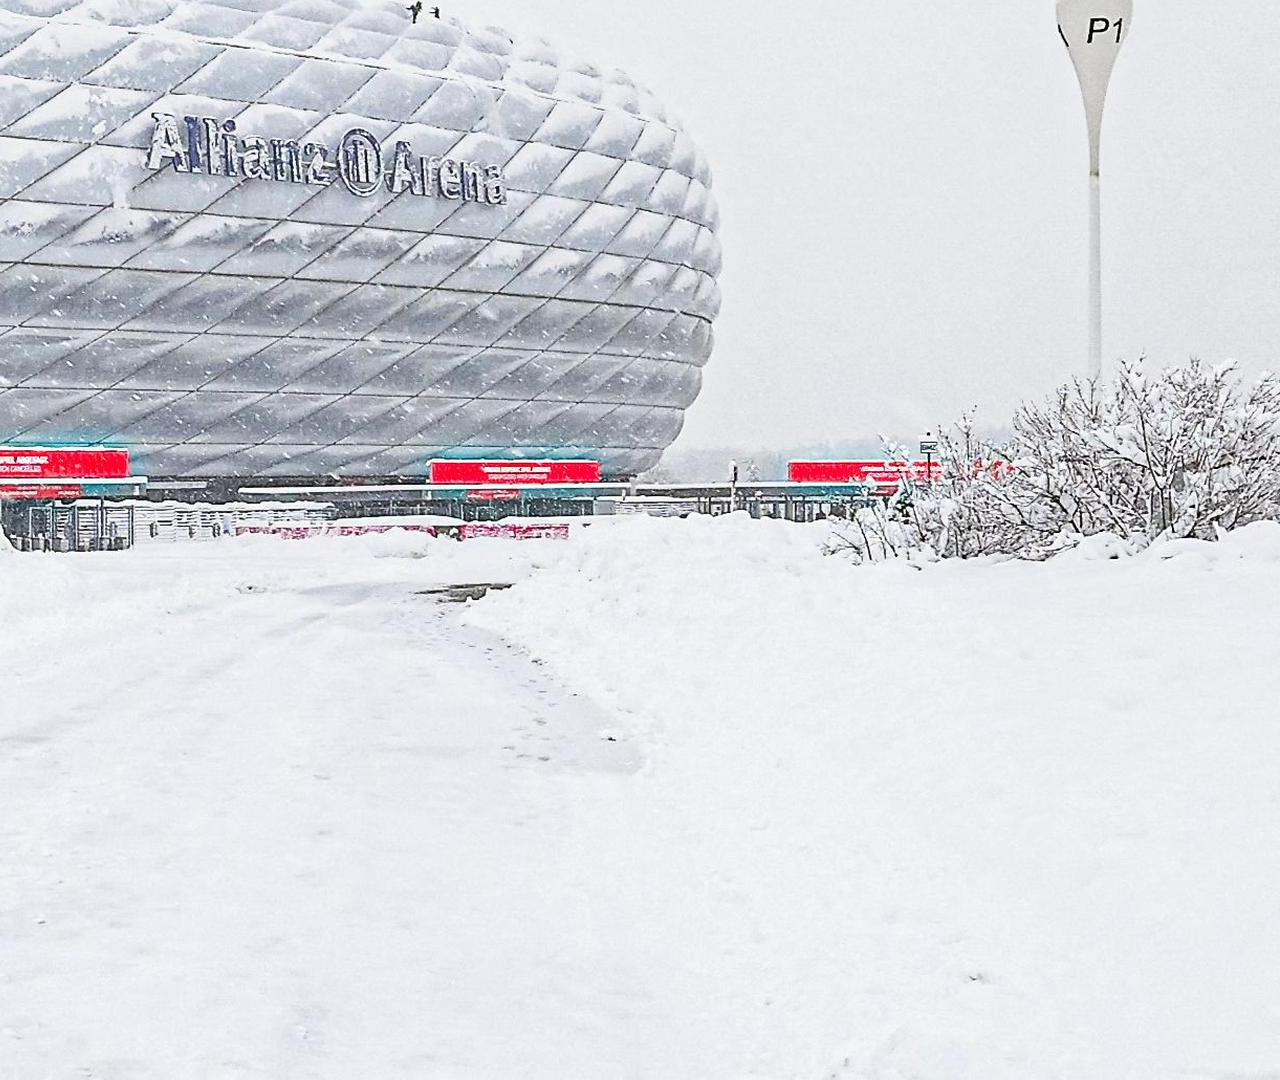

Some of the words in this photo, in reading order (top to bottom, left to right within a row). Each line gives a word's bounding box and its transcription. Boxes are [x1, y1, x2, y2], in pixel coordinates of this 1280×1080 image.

[1086, 17, 1123, 44] P1
[145, 112, 332, 186] Allianz
[390, 140, 508, 206] Arena
